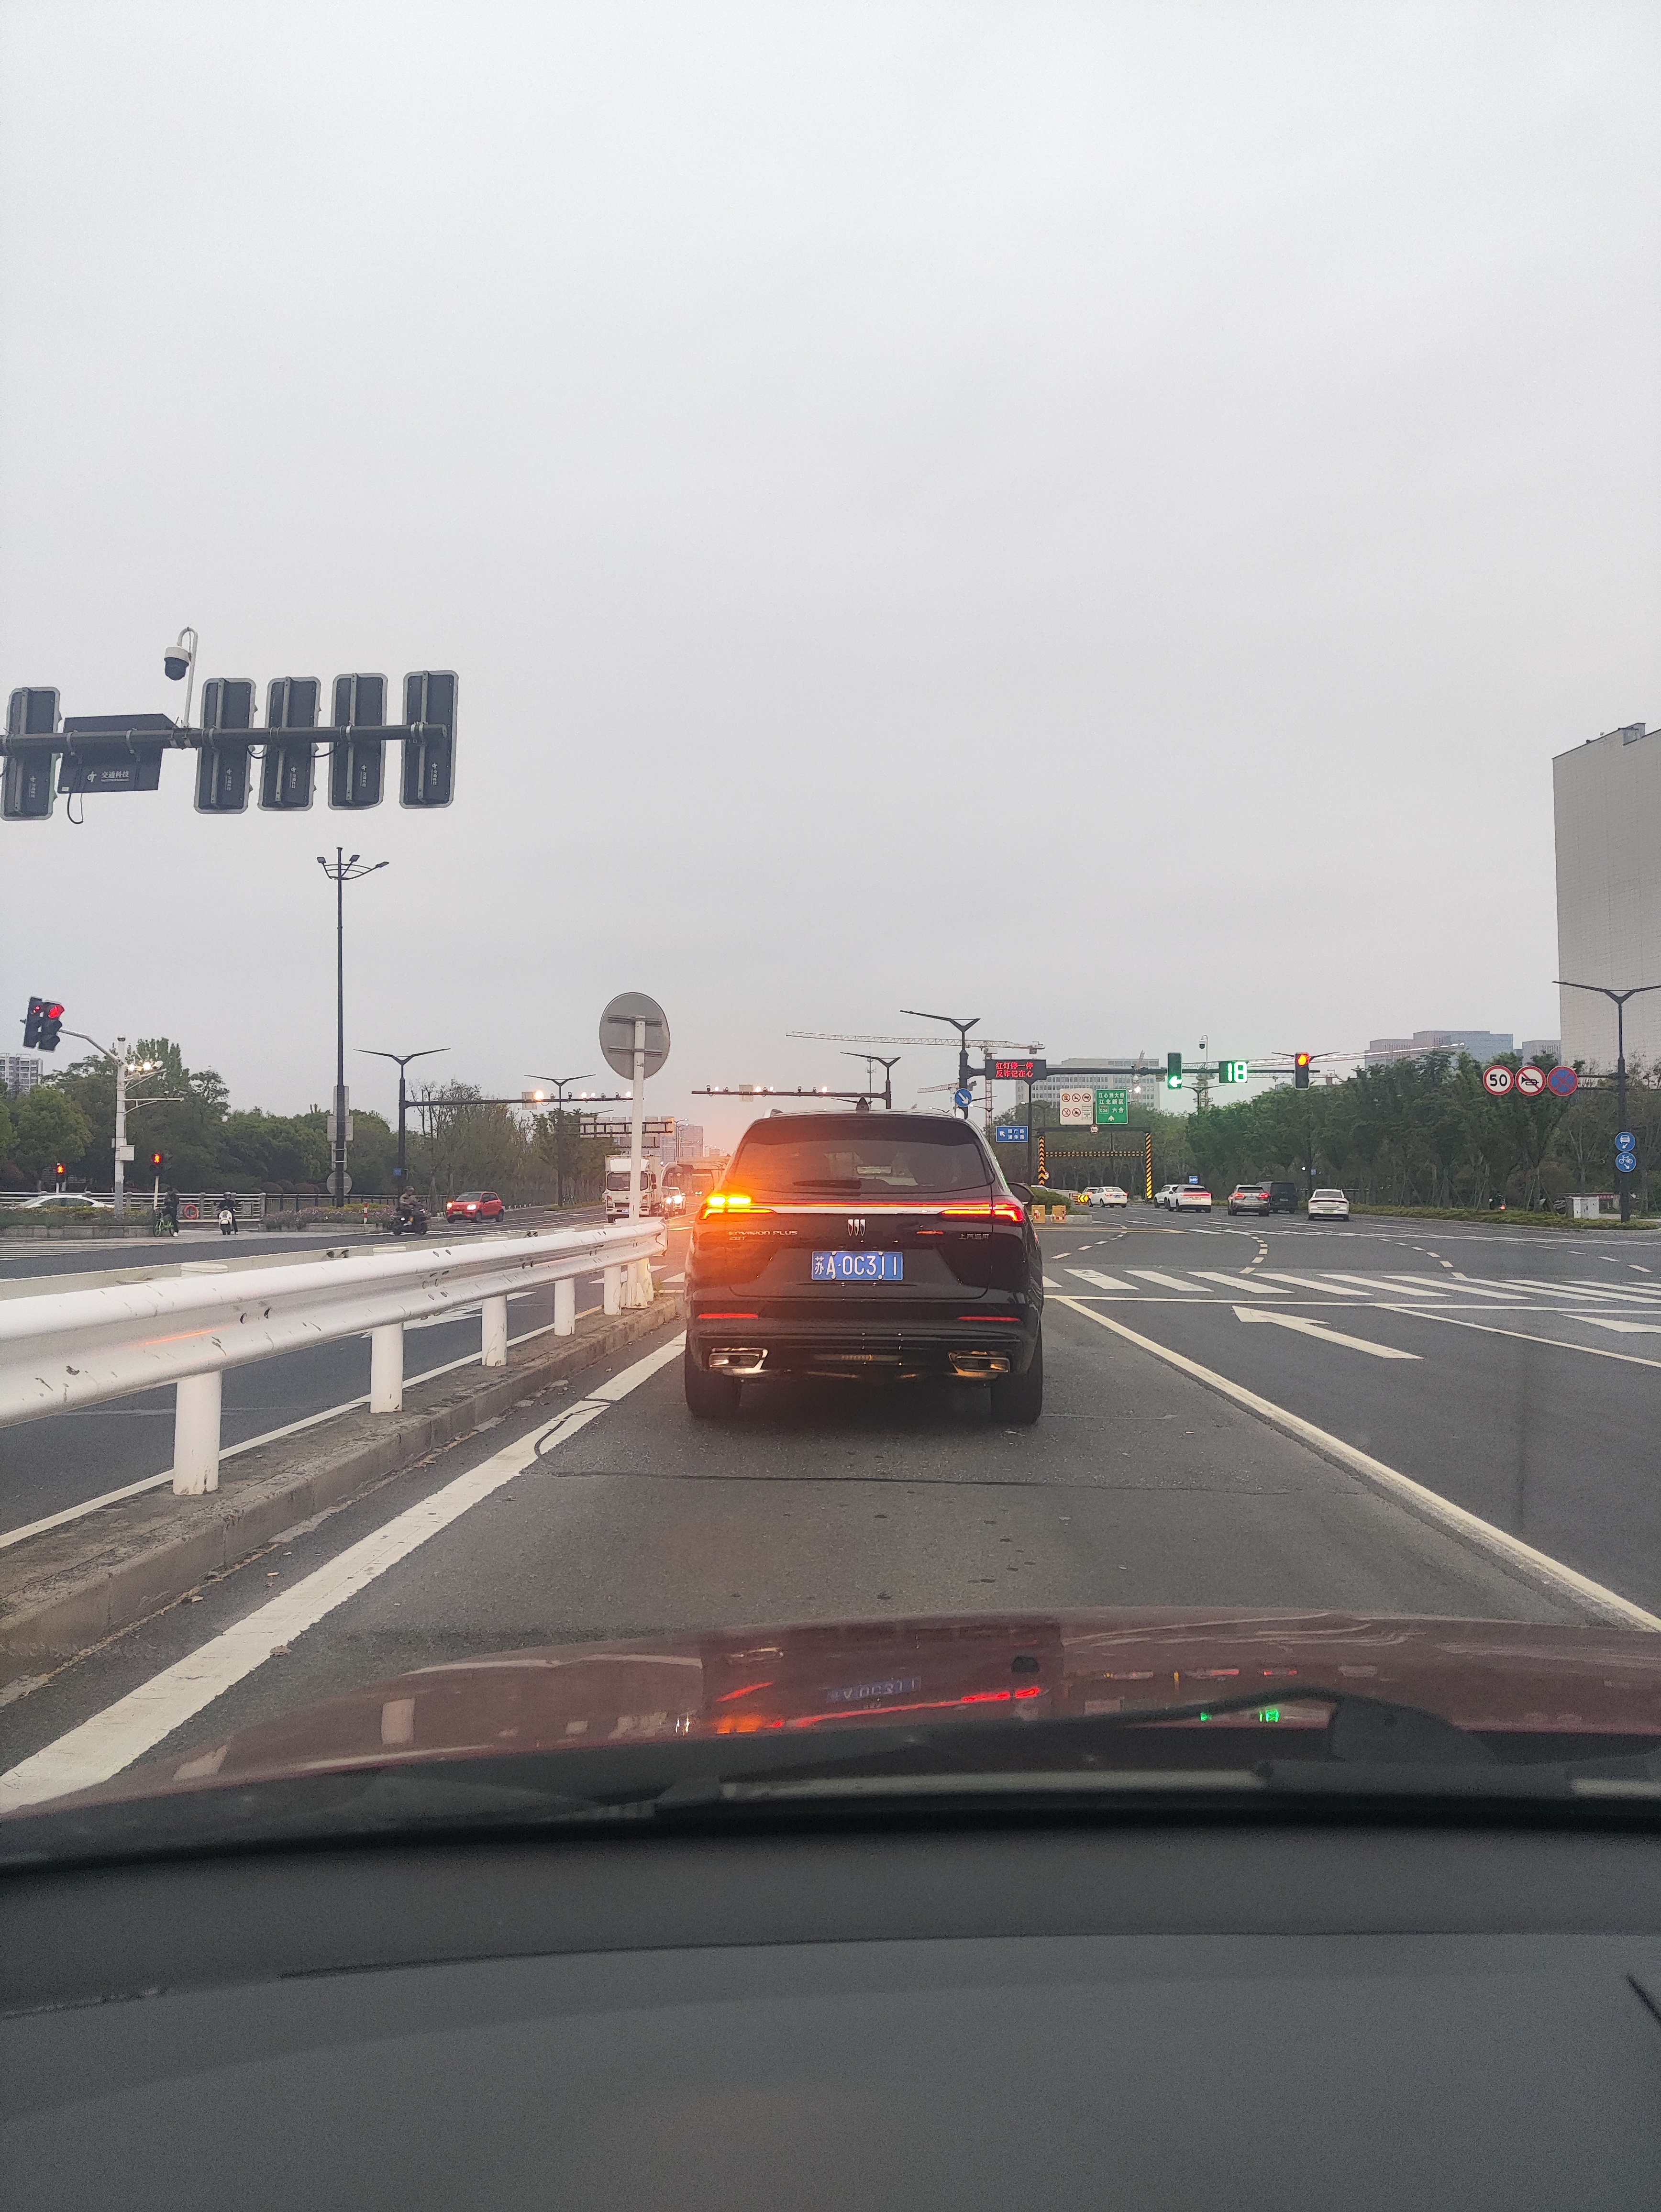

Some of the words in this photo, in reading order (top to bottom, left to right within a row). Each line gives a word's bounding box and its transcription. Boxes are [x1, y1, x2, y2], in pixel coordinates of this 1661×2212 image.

[101, 770, 130, 779] 交通科技
[996, 1062, 1033, 1070] 红灯停一停
[996, 1070, 1033, 1078] 反诈记在心
[1228, 1062, 1247, 1083] 18
[1490, 1074, 1507, 1086] 50
